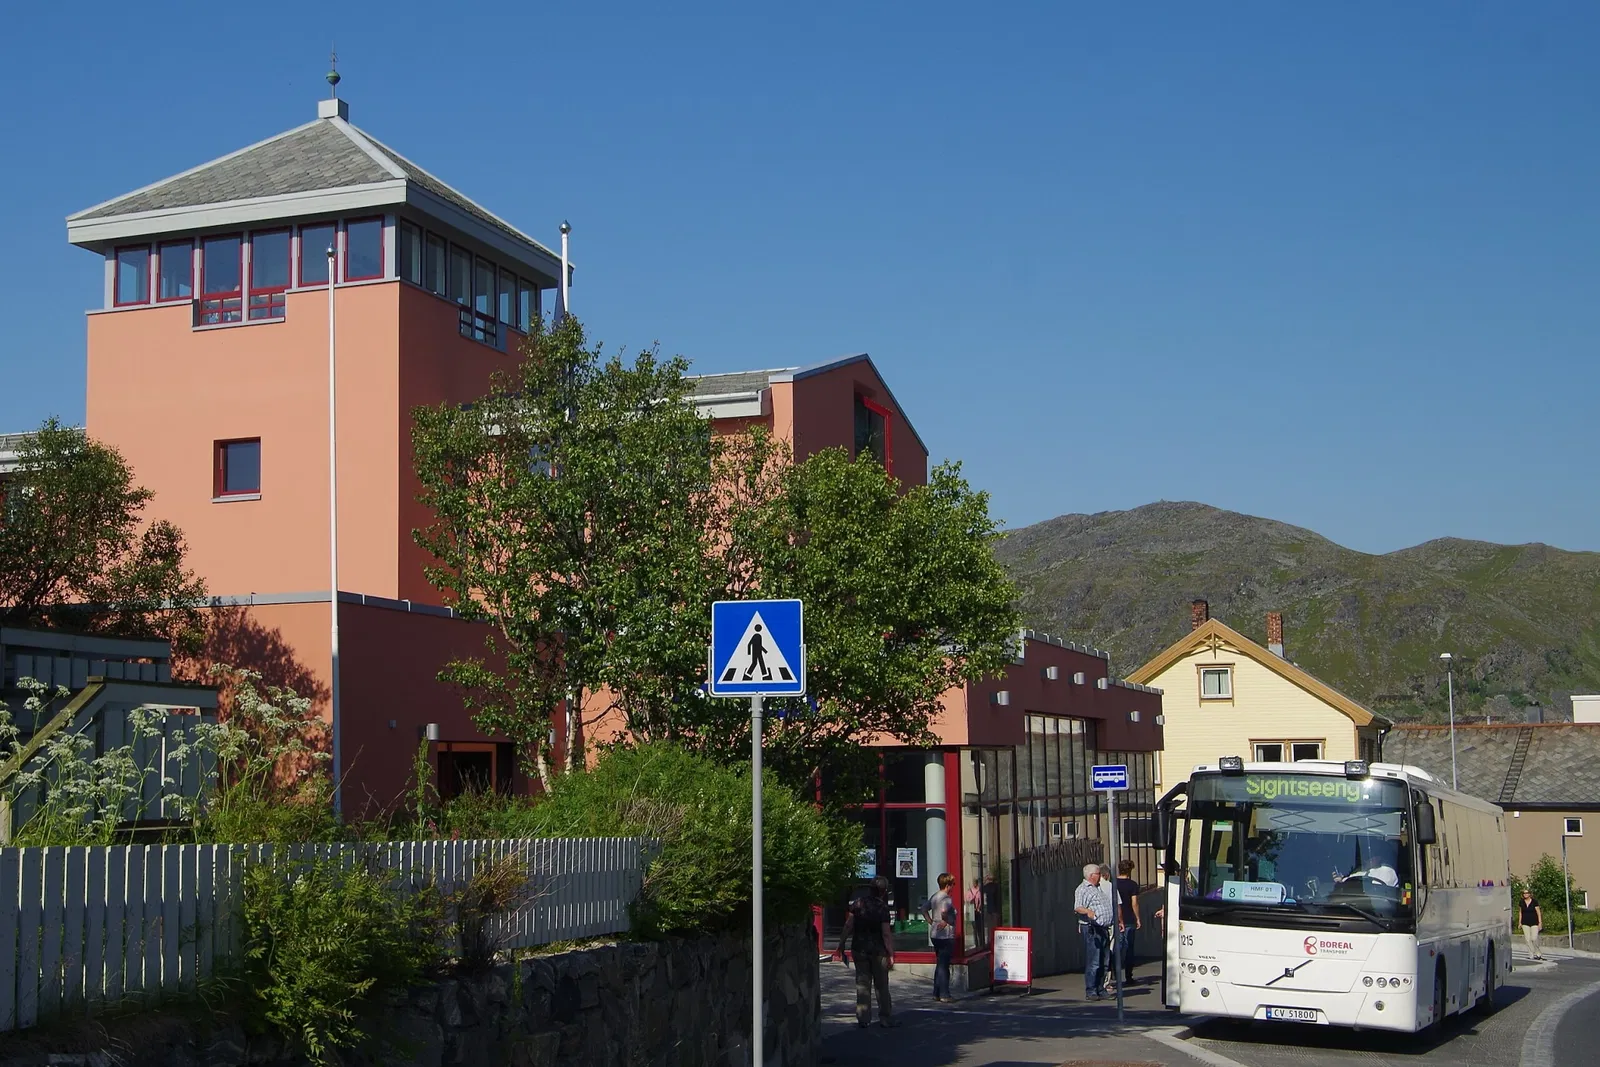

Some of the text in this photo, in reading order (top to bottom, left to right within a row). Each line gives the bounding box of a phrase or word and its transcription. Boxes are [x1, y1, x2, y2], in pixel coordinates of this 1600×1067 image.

[1229, 887, 1236, 898] 8
[1180, 934, 1194, 946] 1215
[1320, 940, 1353, 950] BOREAL
[1274, 1008, 1315, 1019] CV 51800
